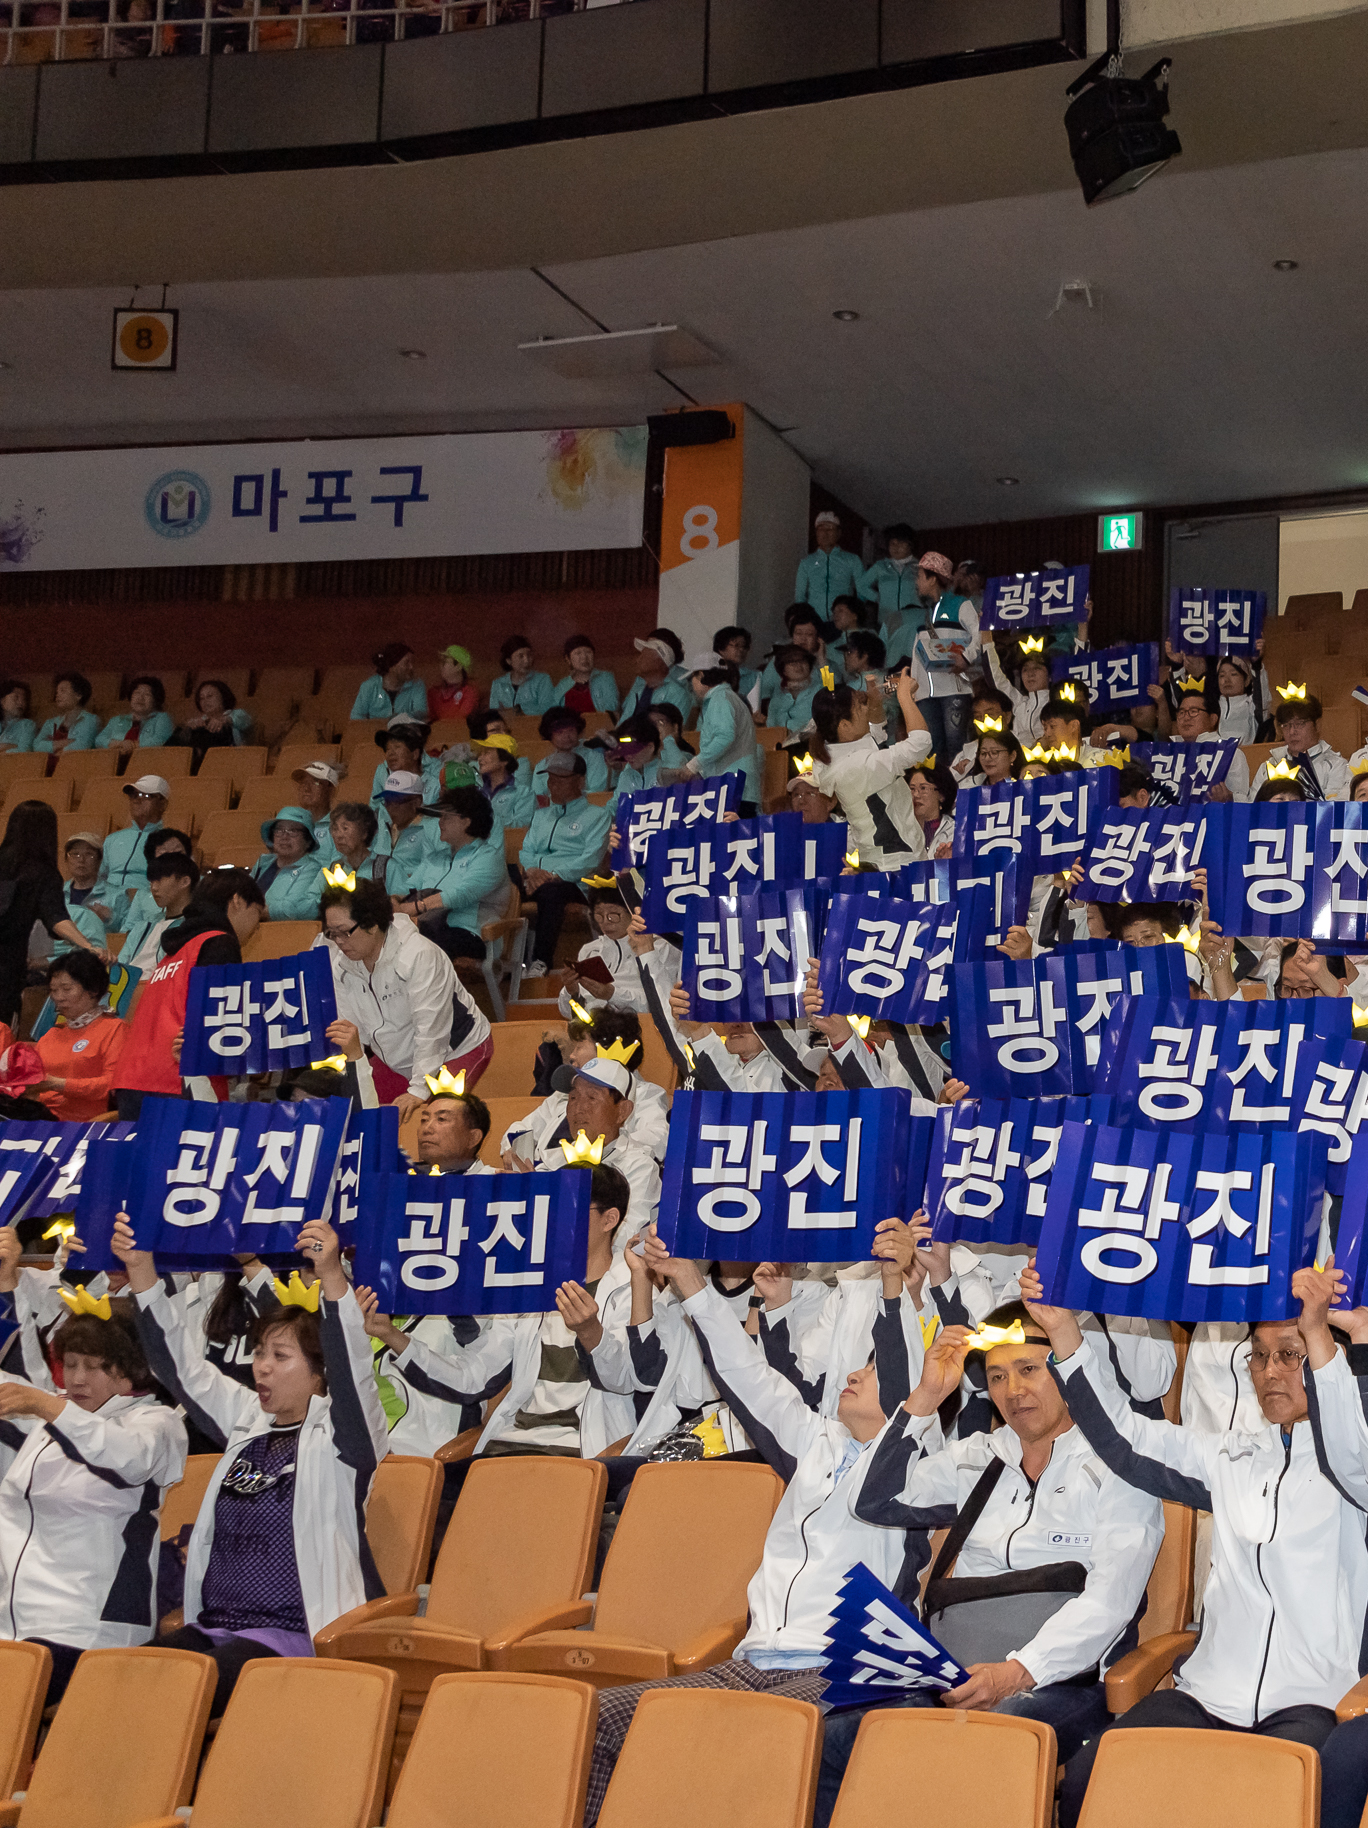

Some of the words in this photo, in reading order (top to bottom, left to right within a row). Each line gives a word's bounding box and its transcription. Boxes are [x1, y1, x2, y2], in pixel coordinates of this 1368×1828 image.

[136, 328, 152, 350] 8
[231, 463, 430, 533] 마포구
[679, 504, 719, 560] 8
[996, 574, 1075, 620] 광진
[1180, 600, 1252, 645] 광진
[1068, 652, 1140, 704] 광진
[1151, 750, 1224, 800] 광진
[974, 784, 1088, 856] 광진
[1090, 816, 1206, 888] 광진
[150, 960, 183, 985] TAFF
[694, 910, 809, 1001] 광진
[204, 970, 311, 1058] 광진
[1137, 1023, 1306, 1123] 광진
[163, 1124, 324, 1227] 광진
[692, 1116, 863, 1233] 광진
[398, 1194, 551, 1291] 광진
[1077, 1162, 1276, 1287] 광진
